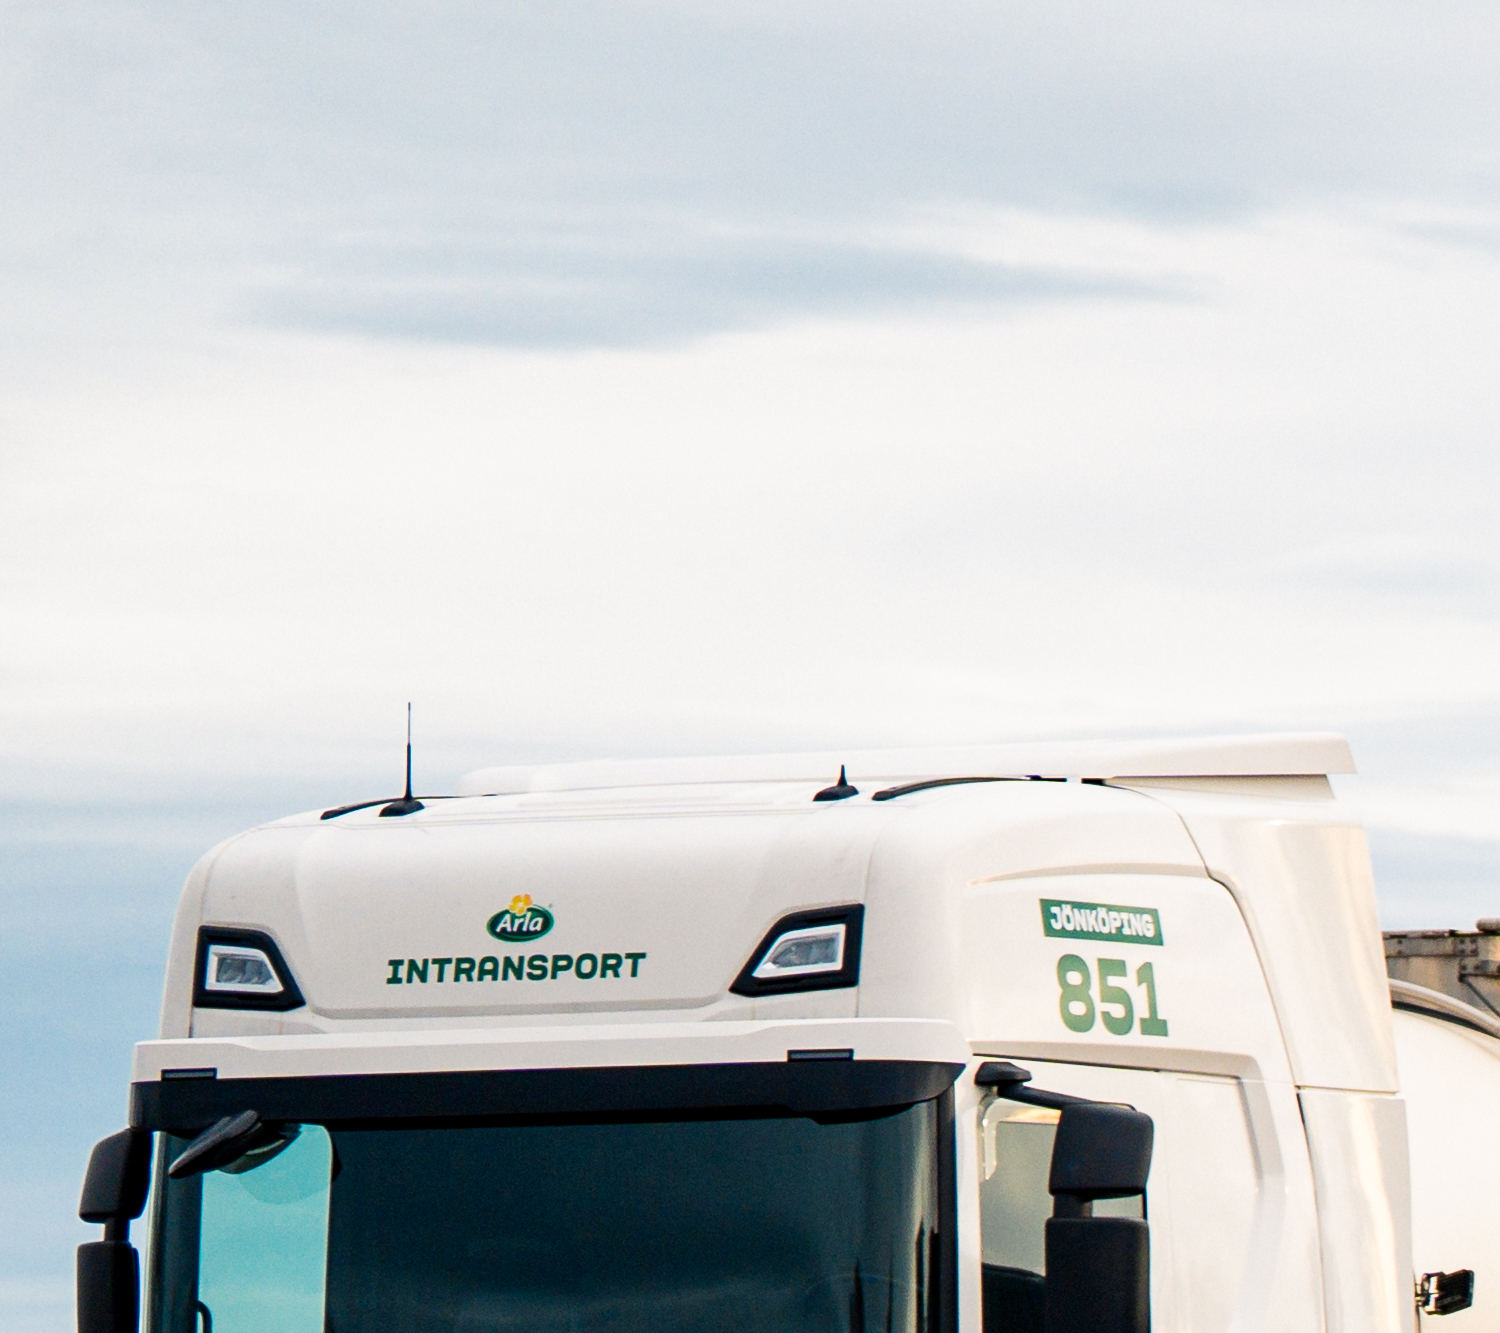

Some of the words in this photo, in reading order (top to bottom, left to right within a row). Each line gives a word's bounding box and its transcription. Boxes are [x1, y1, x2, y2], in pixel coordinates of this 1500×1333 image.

[495, 911, 544, 932] Arla
[1050, 903, 1155, 937] JÖNKÖPING
[386, 952, 647, 984] INTRANSPORT
[1056, 953, 1169, 1037] 851
